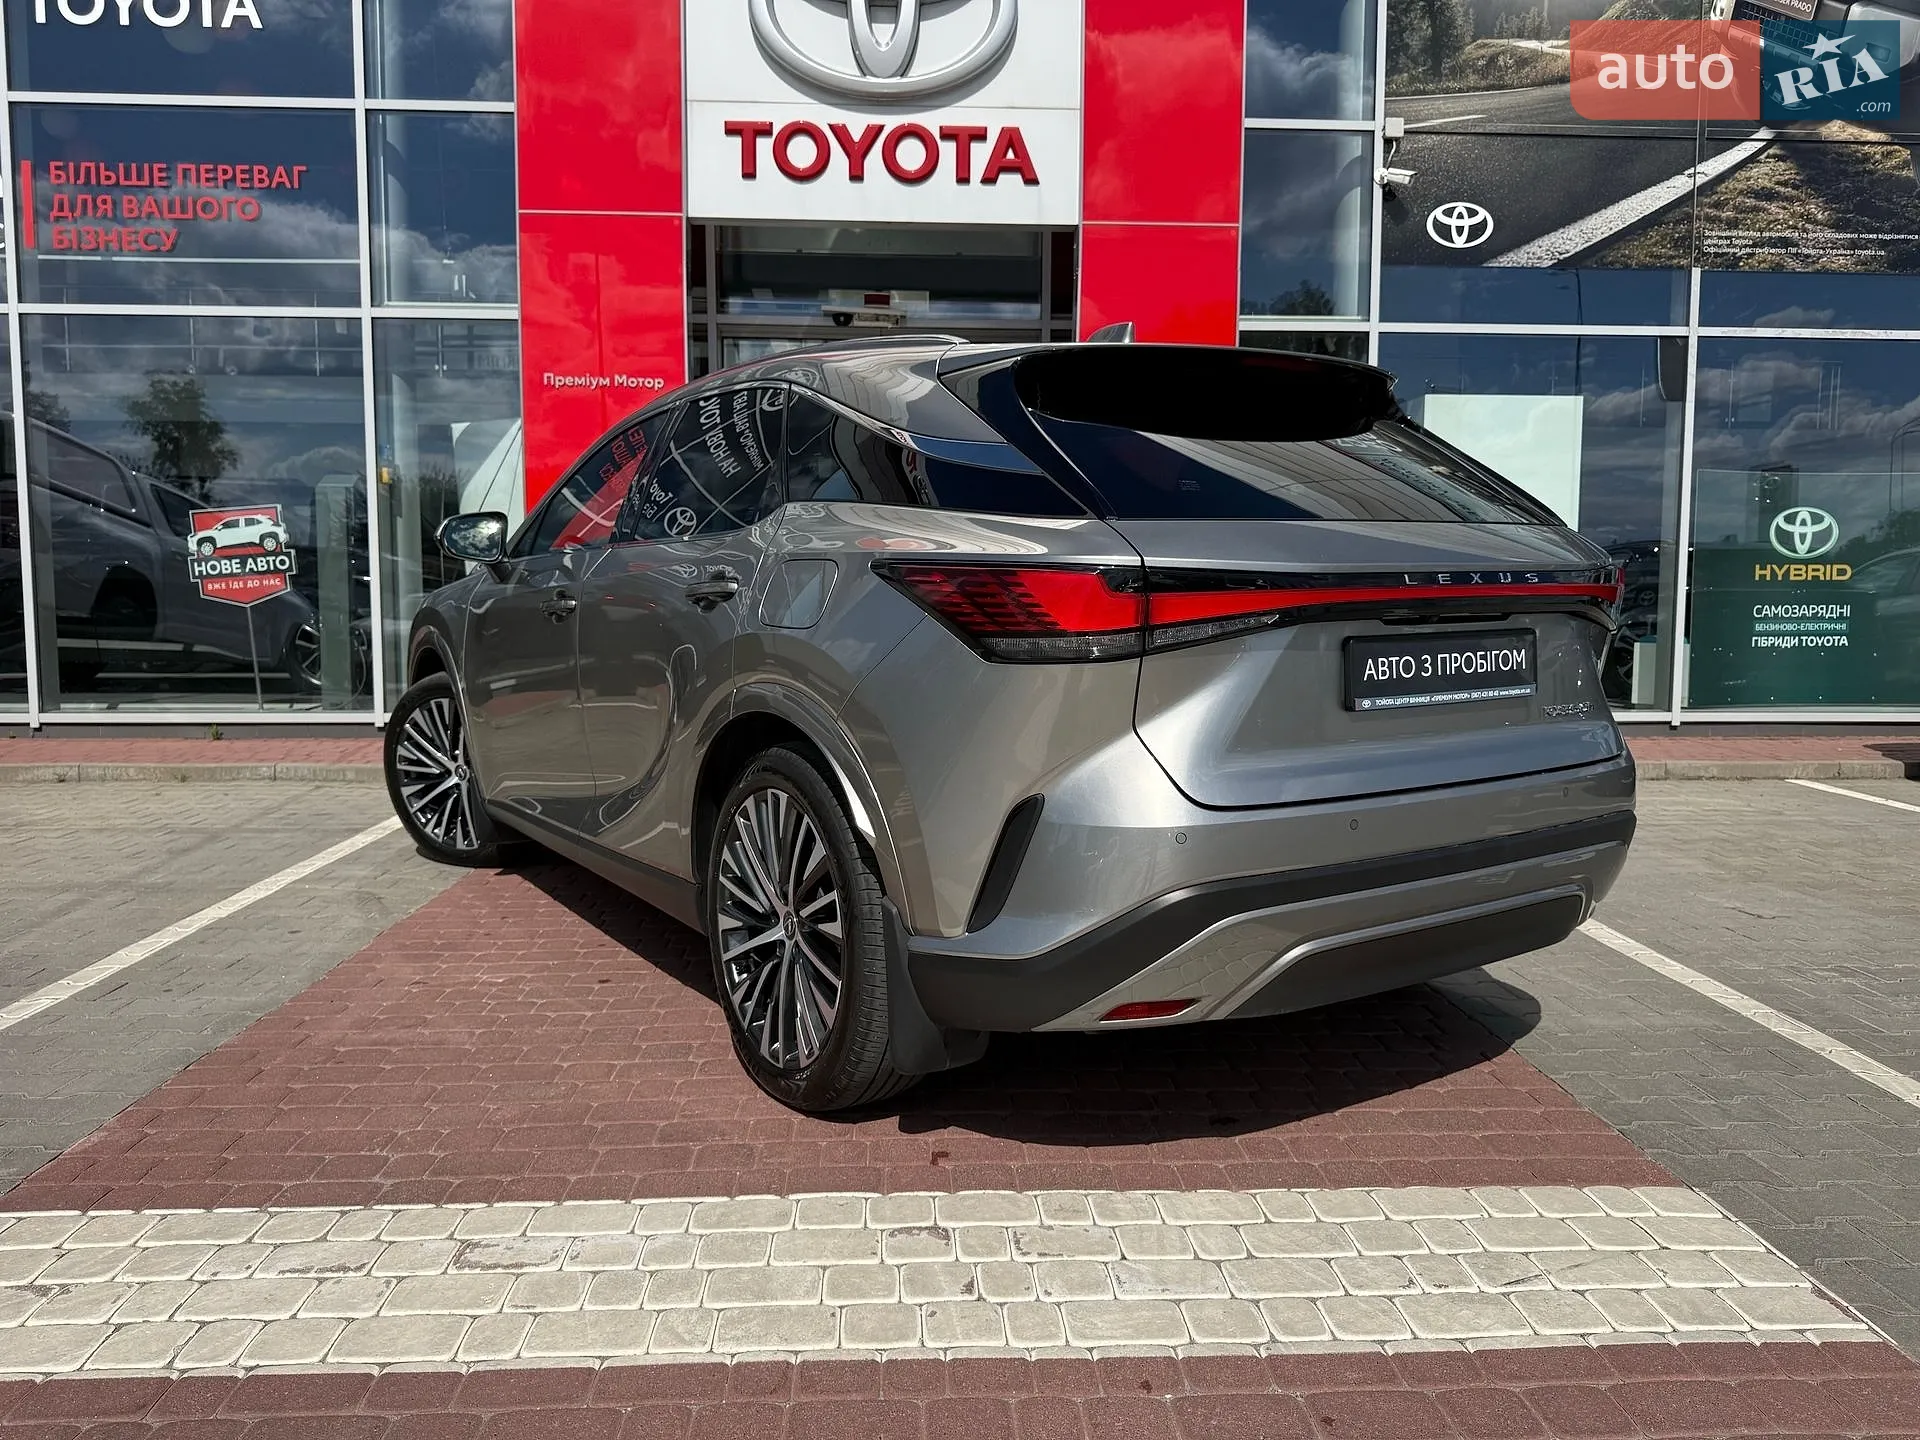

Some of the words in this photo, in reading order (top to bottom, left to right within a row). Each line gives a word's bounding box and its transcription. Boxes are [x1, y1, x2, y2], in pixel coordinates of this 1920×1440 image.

[724, 119, 1041, 186] TOYOTA
[49, 161, 168, 187] БІЛЬШЕ
[177, 163, 308, 189] ПЕРЕВАГ
[50, 194, 113, 220] ДЛЯ
[122, 196, 261, 221] ВАШОГО
[52, 225, 179, 252] БІЗНЕСУ
[543, 372, 611, 389] Преміум
[614, 374, 664, 391] Мотор
[194, 559, 241, 576] НОВЕ
[245, 555, 290, 572] АВТО
[1754, 564, 1853, 581] HYBRID
[207, 581, 226, 590] ВЖЕ
[229, 580, 243, 589] ЇДЕ
[247, 579, 260, 588] ДО
[263, 578, 282, 586] НАС
[1403, 572, 1540, 585] LEXUS
[1753, 604, 1851, 619] САМОЗАРЯДНІ
[1755, 623, 1847, 631] БЕНЗИНОВО-ЕЛЕКТРИЧНІ
[1751, 636, 1799, 648] ГІБРИДИ
[1800, 636, 1849, 647] TOYOTA
[1363, 655, 1416, 681] АВТО
[1437, 648, 1527, 676] ПРОБІГОМ
